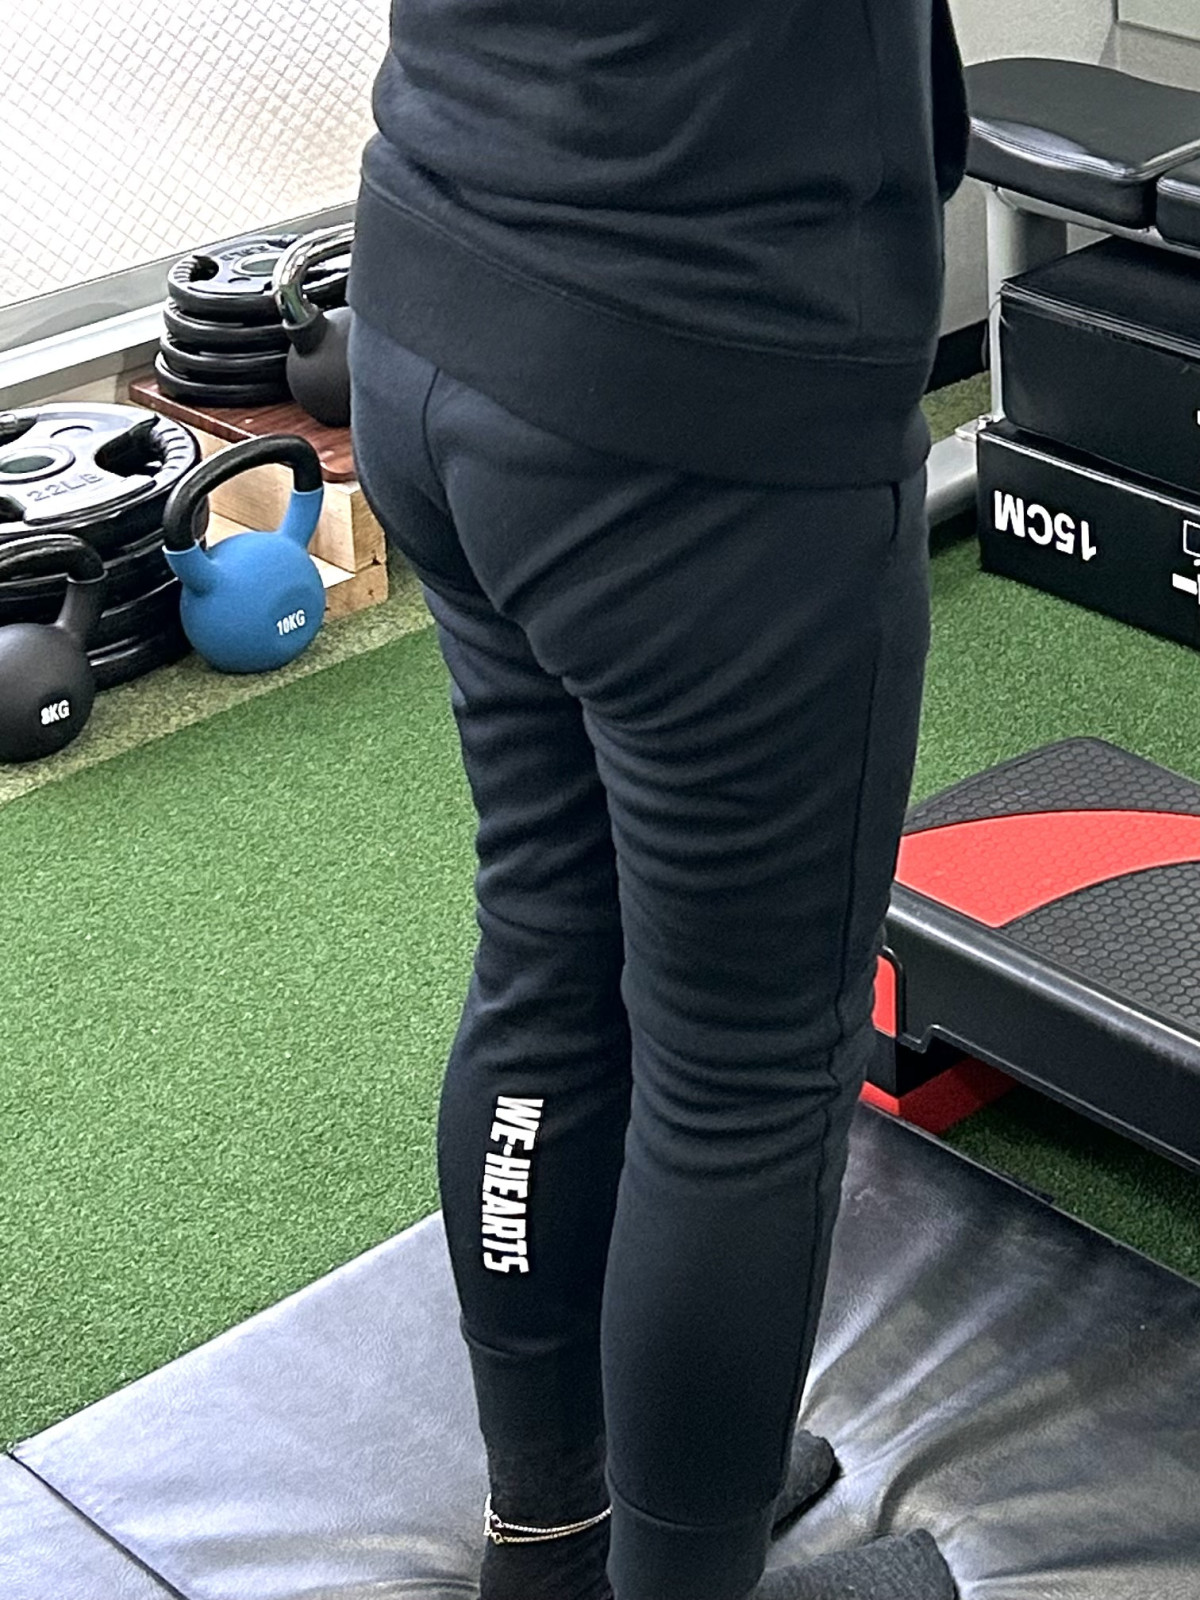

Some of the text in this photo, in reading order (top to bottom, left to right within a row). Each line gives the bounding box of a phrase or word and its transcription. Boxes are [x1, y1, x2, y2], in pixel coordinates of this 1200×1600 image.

[993, 489, 1097, 562] 15CM
[276, 609, 306, 636] 10KG
[40, 699, 70, 726] 8KG
[481, 1095, 545, 1274] WE-HEARTS
